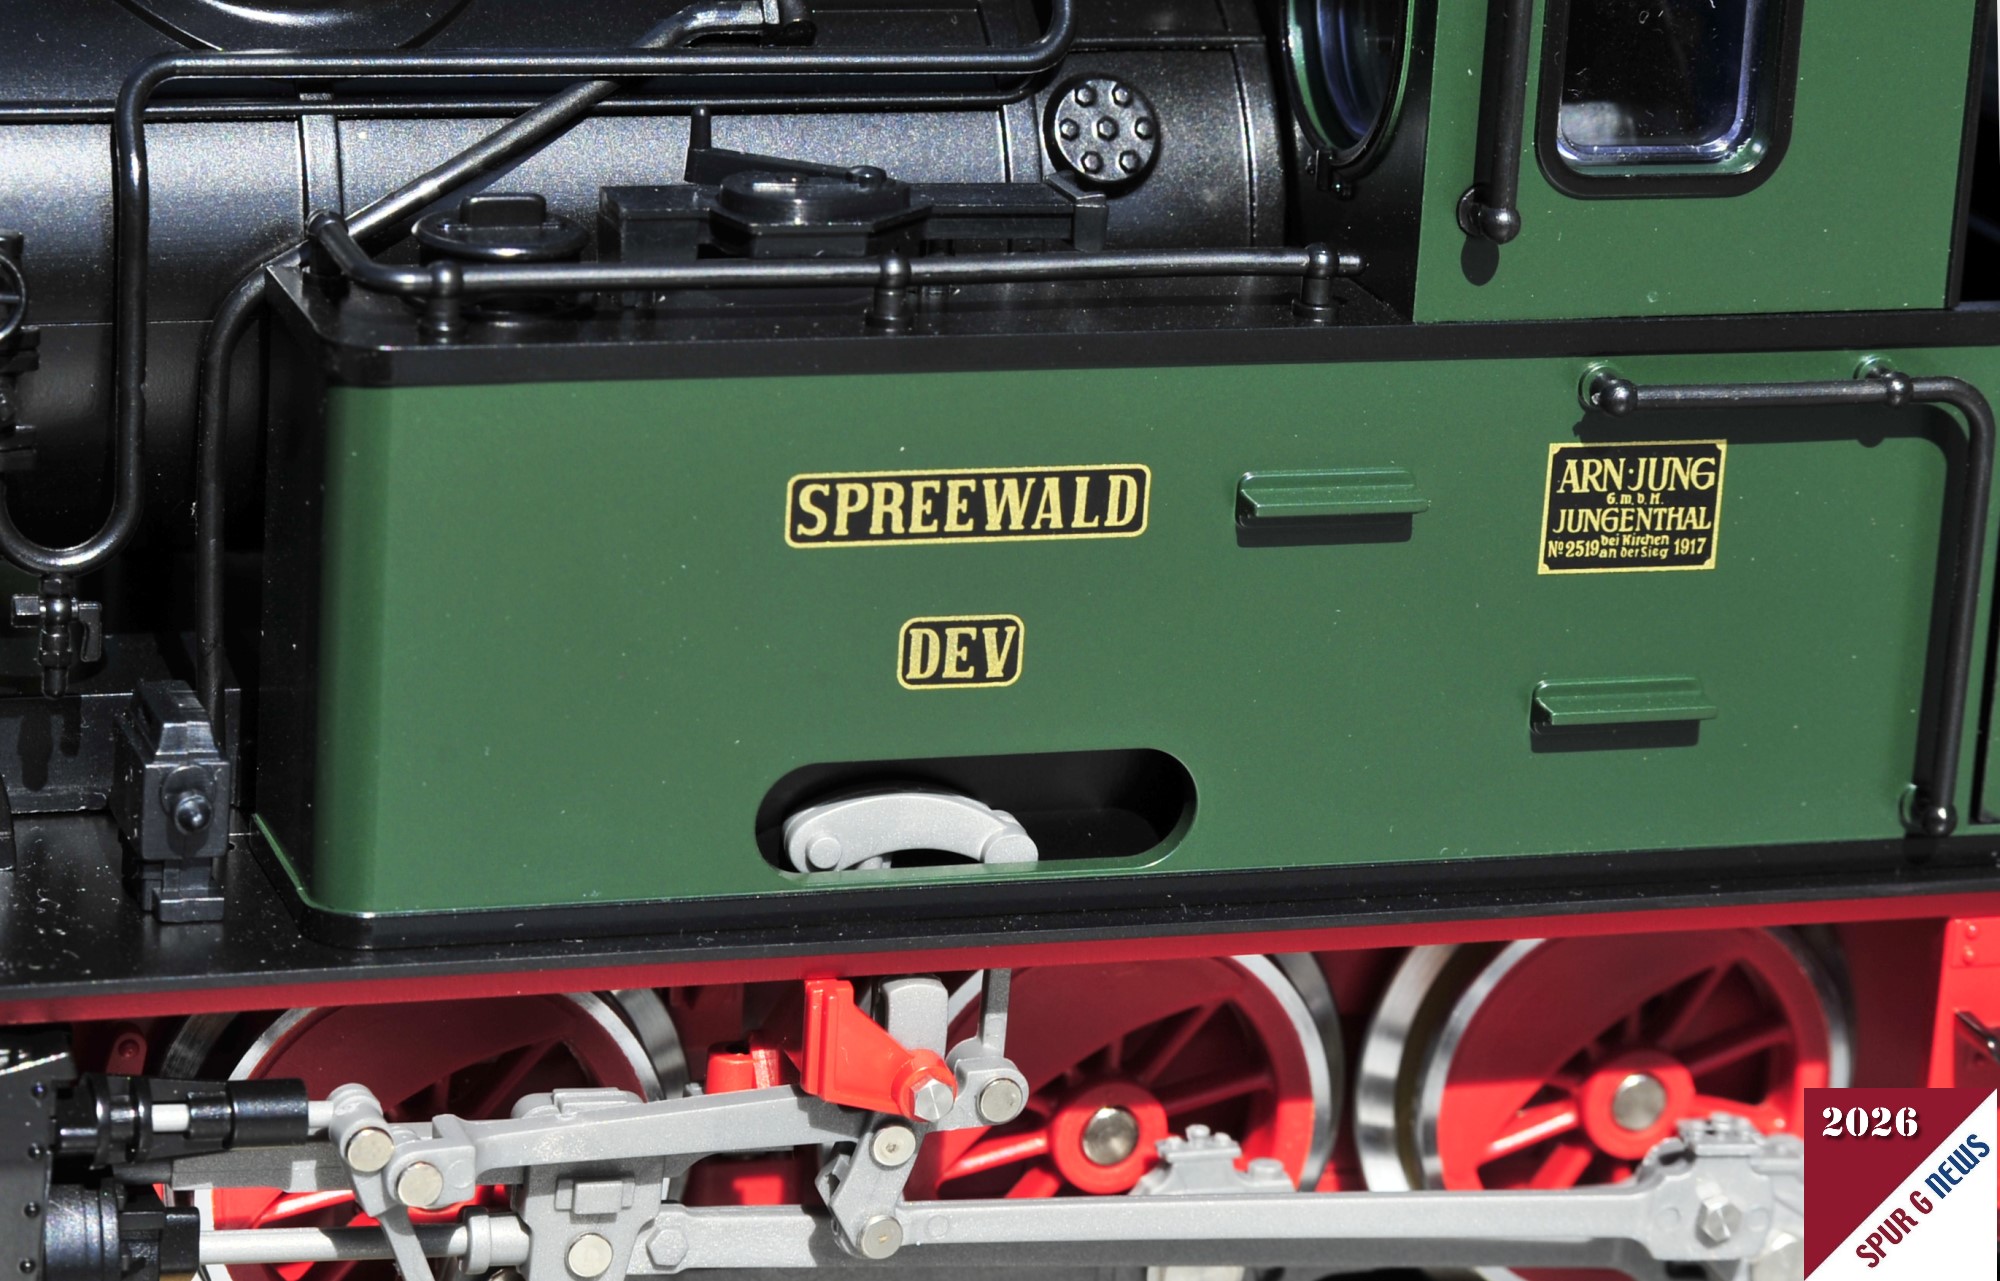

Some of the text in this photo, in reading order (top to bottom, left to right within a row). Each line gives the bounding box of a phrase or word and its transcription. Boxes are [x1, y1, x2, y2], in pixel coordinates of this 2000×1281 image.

[797, 474, 1138, 536] SPREEWALD
[1552, 506, 1712, 533] JUNGENTHAL
[1600, 532, 1670, 546] bei Kirchen
[1673, 537, 1707, 556] 1917
[1565, 540, 1600, 558] 2519
[1599, 545, 1670, 560] an der Sieg
[906, 625, 1017, 680] DEV
